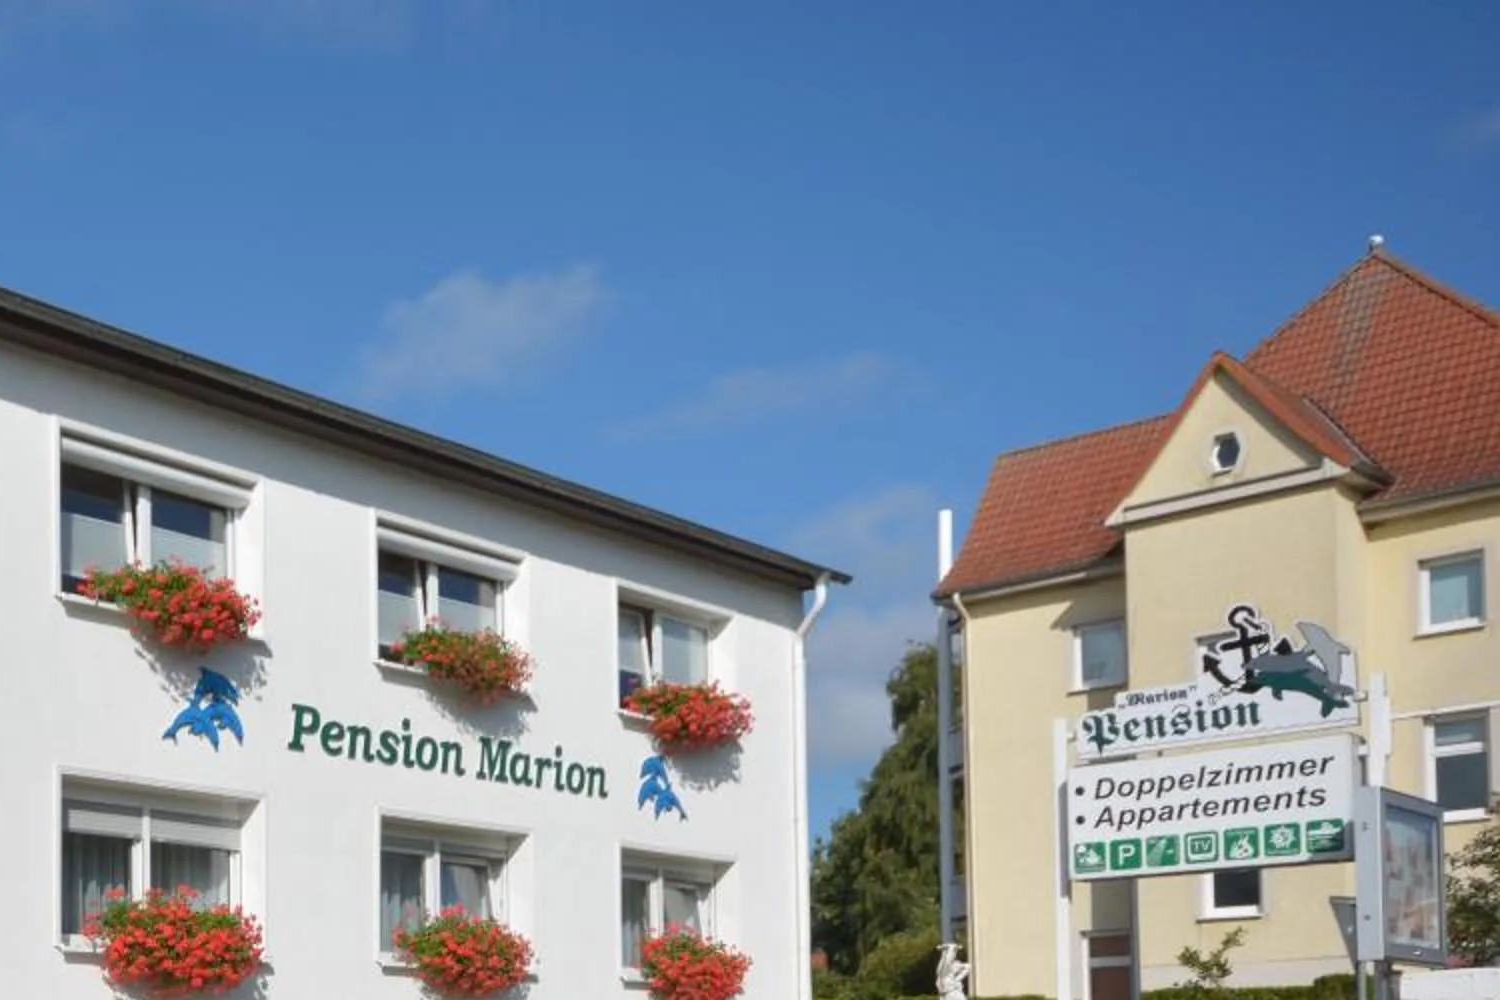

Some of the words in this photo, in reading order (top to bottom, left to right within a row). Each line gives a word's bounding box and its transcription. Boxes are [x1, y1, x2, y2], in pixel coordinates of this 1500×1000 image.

[1082, 700, 1261, 753] Pension
[287, 703, 466, 777] Pension
[475, 735, 609, 800] Marion
[1094, 754, 1335, 801] Doppelzimmer
[1093, 786, 1328, 831] Appartements
[1191, 839, 1212, 853] TV
